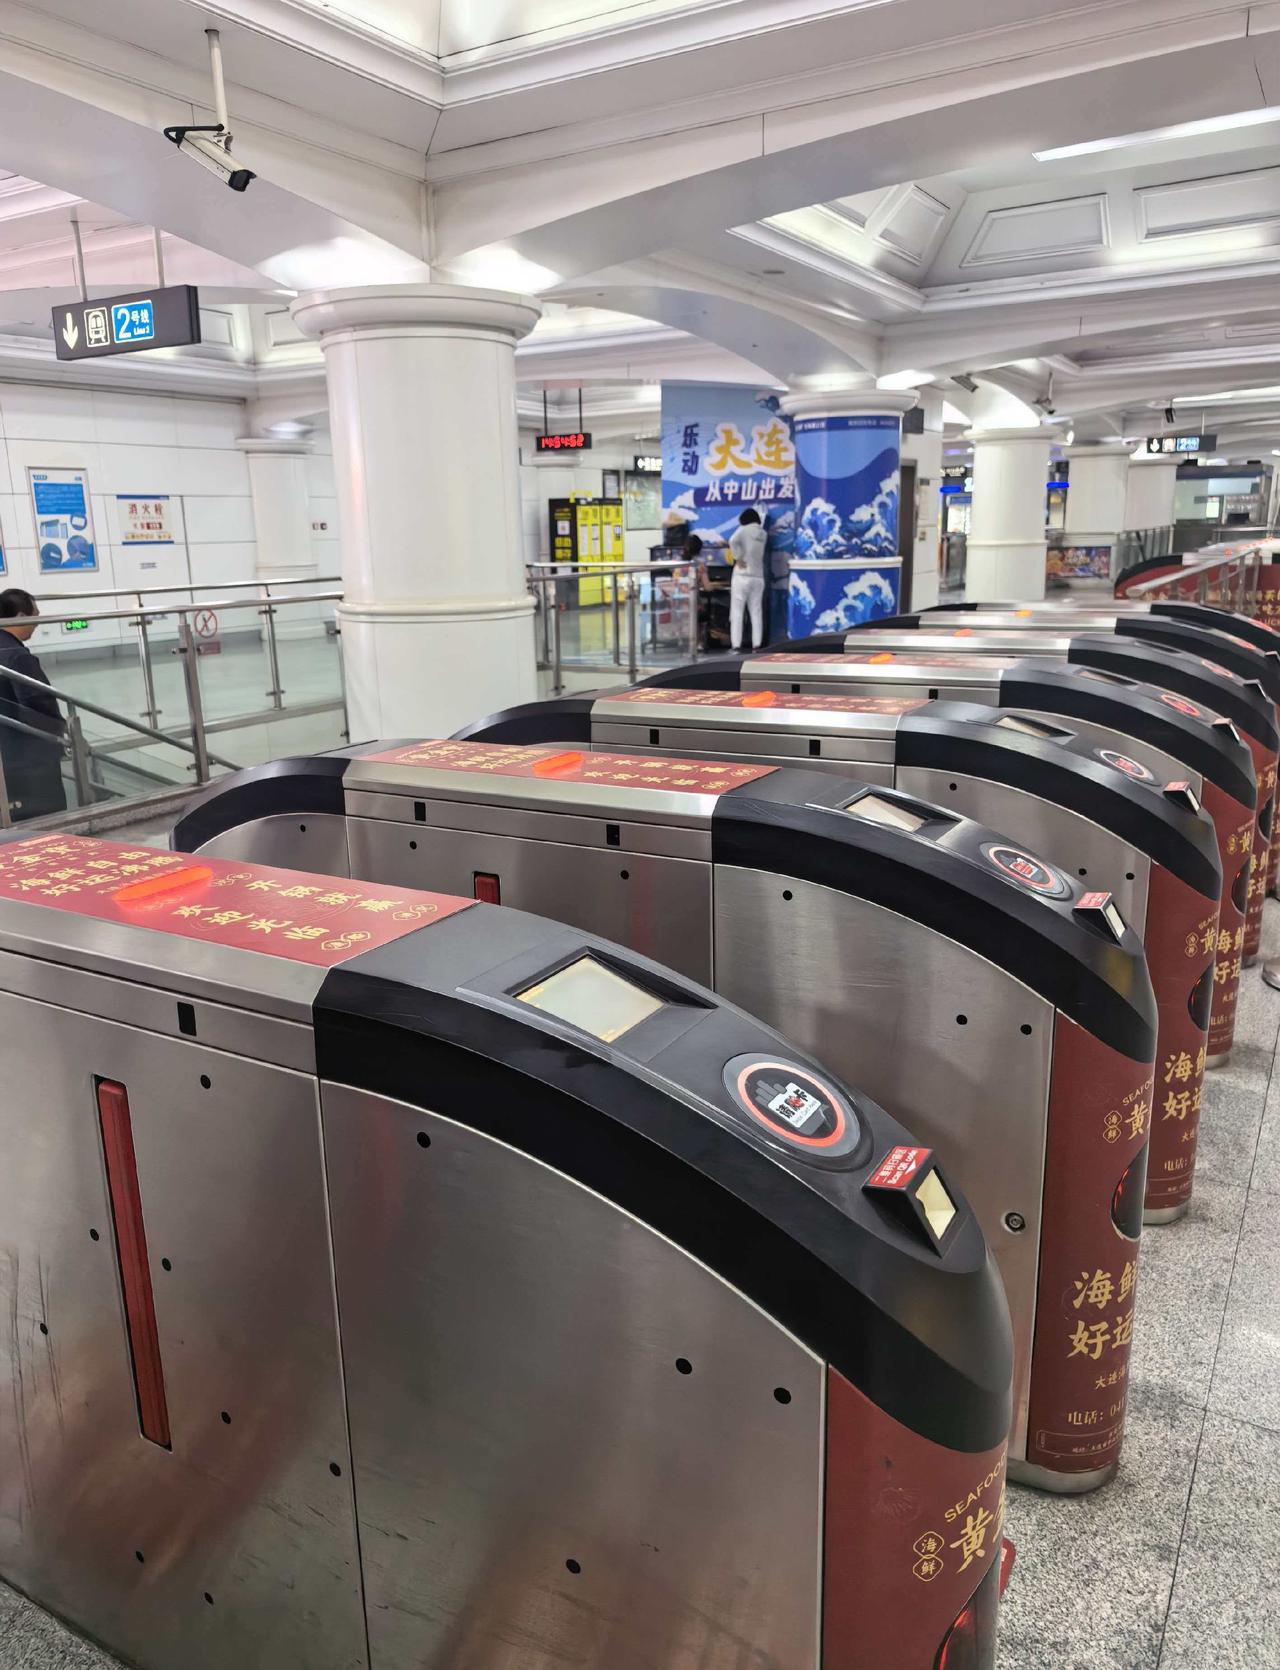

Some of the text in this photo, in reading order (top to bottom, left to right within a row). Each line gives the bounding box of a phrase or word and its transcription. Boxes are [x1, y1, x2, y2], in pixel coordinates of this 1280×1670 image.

[681, 423, 698, 476] 乐动
[709, 423, 795, 471] 大连
[705, 477, 796, 502] 从中山出发
[9, 851, 152, 891] 海鲜自由
[40, 855, 184, 897] 好运沸腾
[171, 903, 331, 940] 欢迎光临
[920, 1537, 938, 1577] 海鲜
